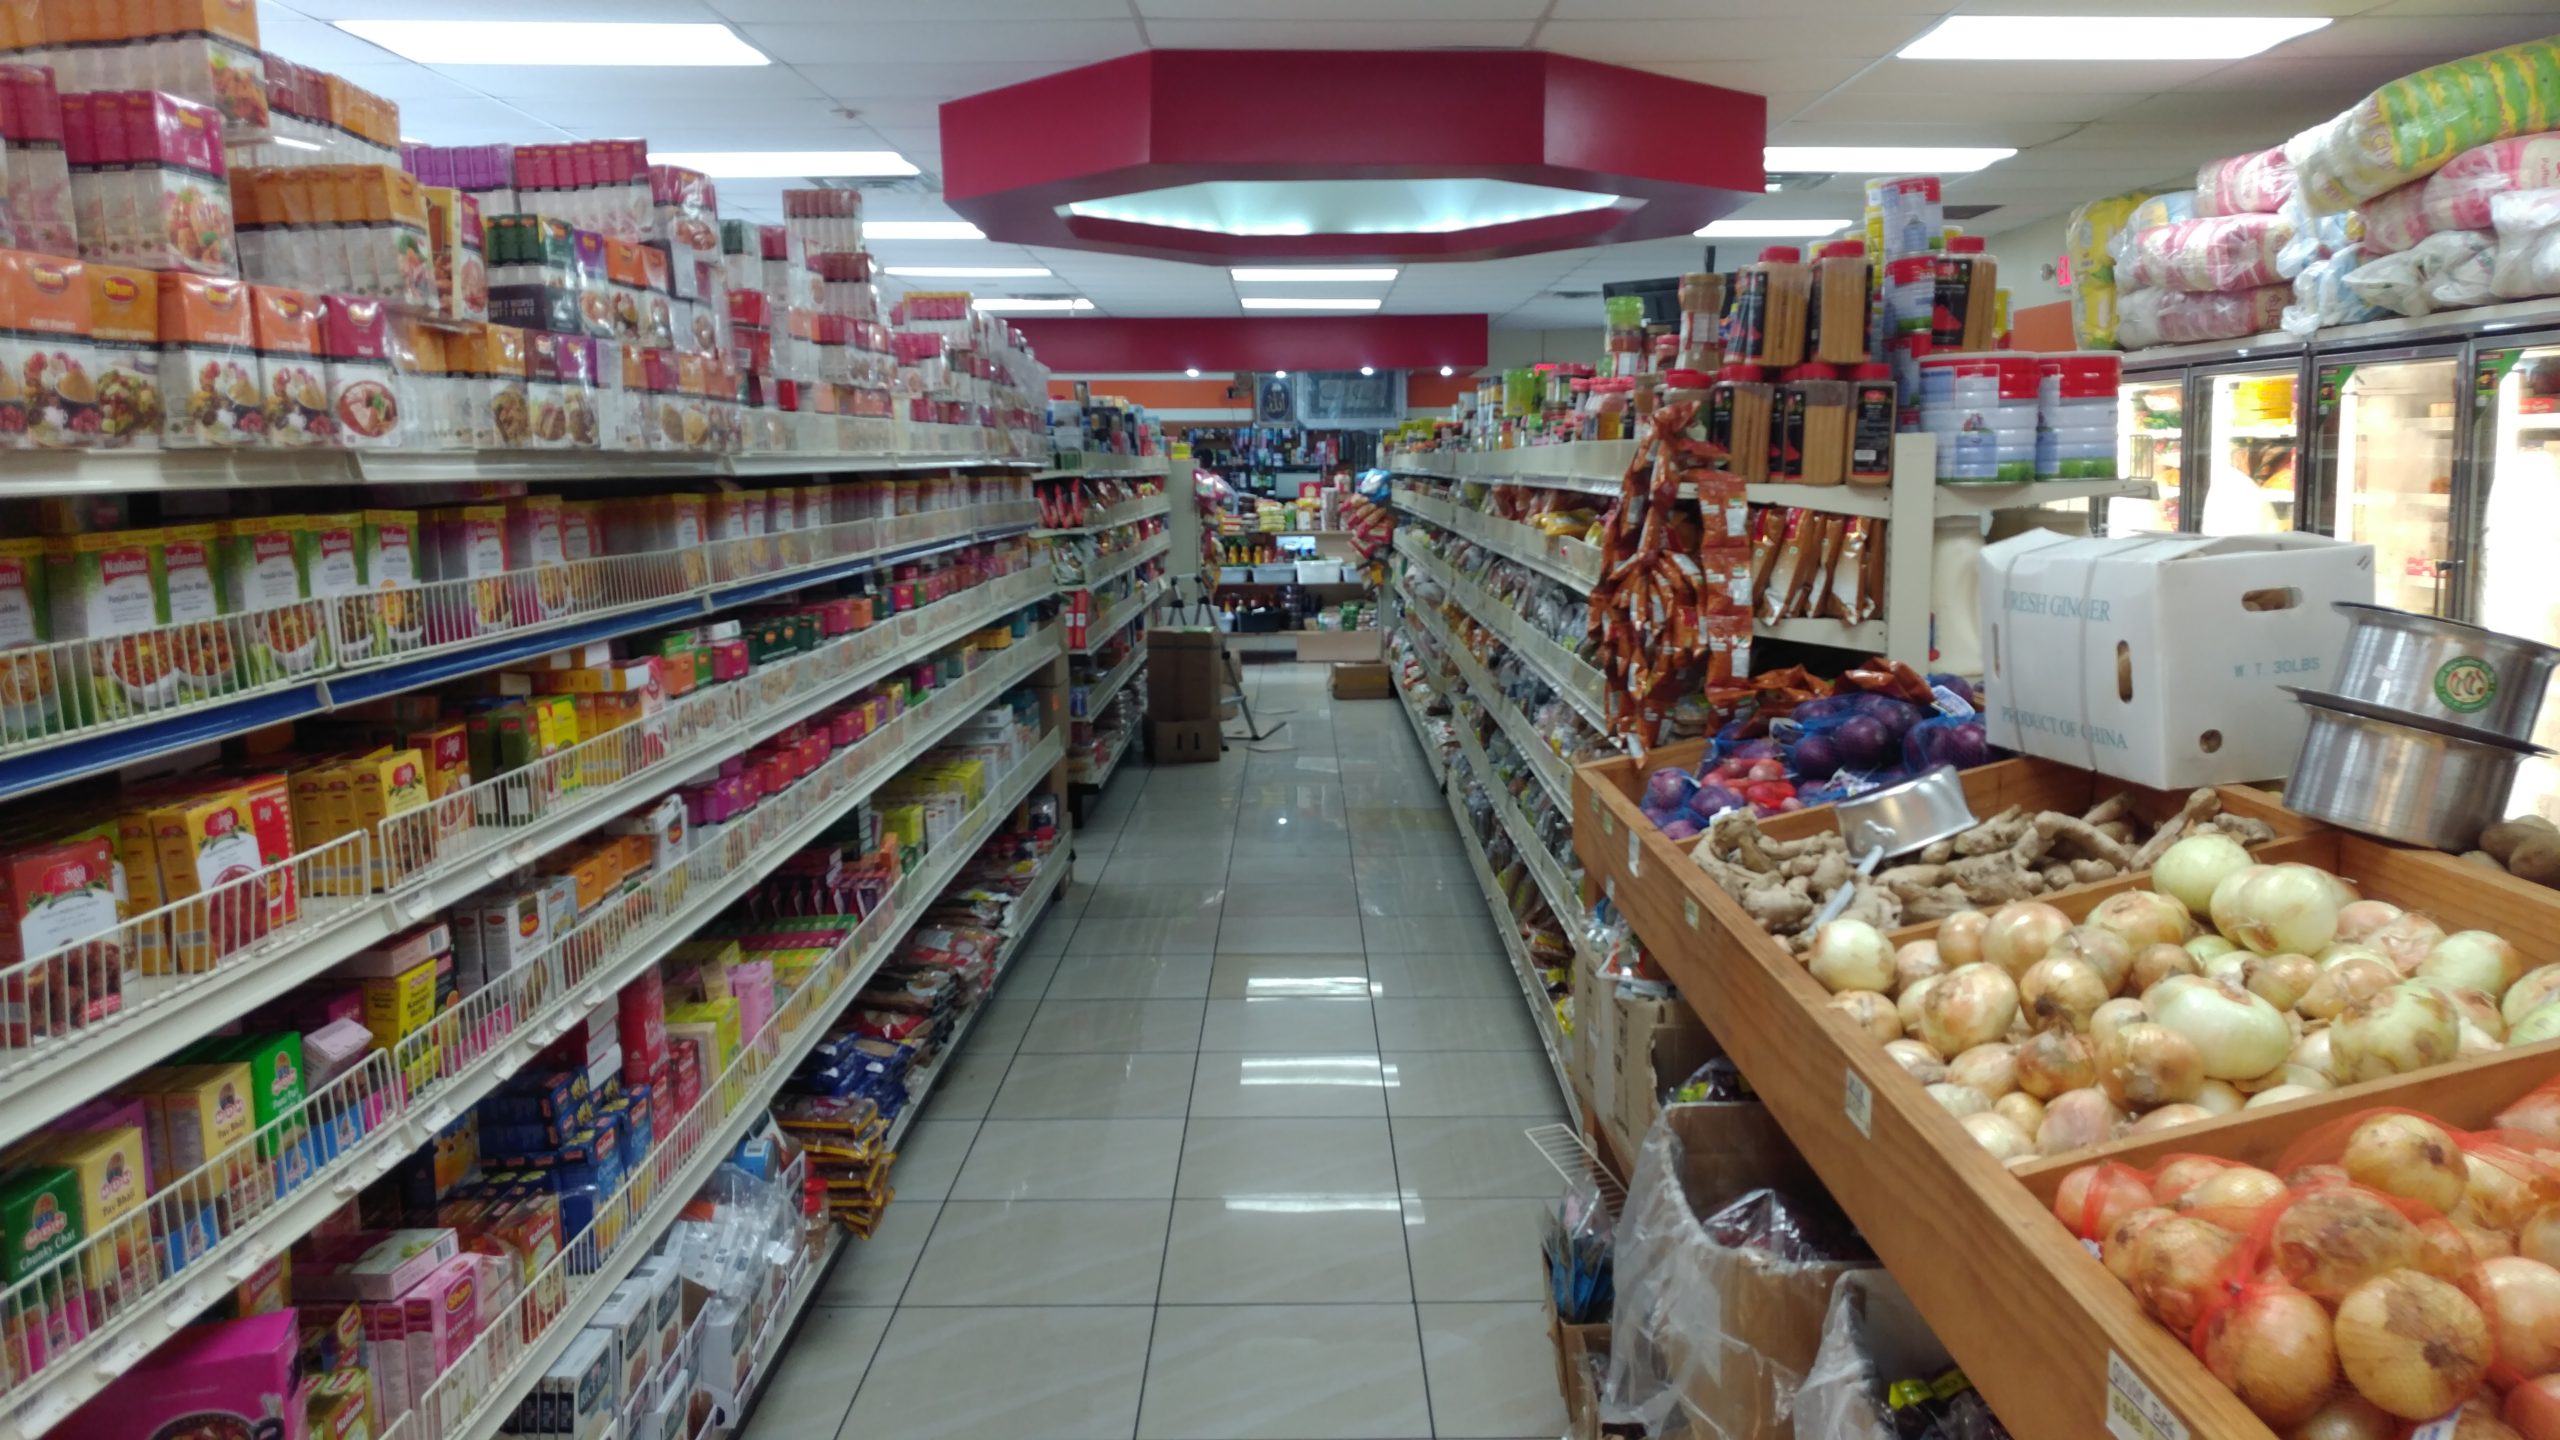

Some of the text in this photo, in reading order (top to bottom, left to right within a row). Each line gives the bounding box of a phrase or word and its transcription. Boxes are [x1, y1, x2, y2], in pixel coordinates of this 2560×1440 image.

[105, 278, 134, 296] Shan
[104, 555, 147, 574] National
[2273, 656, 2320, 675] 30LBS
[2059, 719, 2077, 738] OF
[55, 1230, 76, 1249] Chat
[336, 1393, 365, 1434] National
